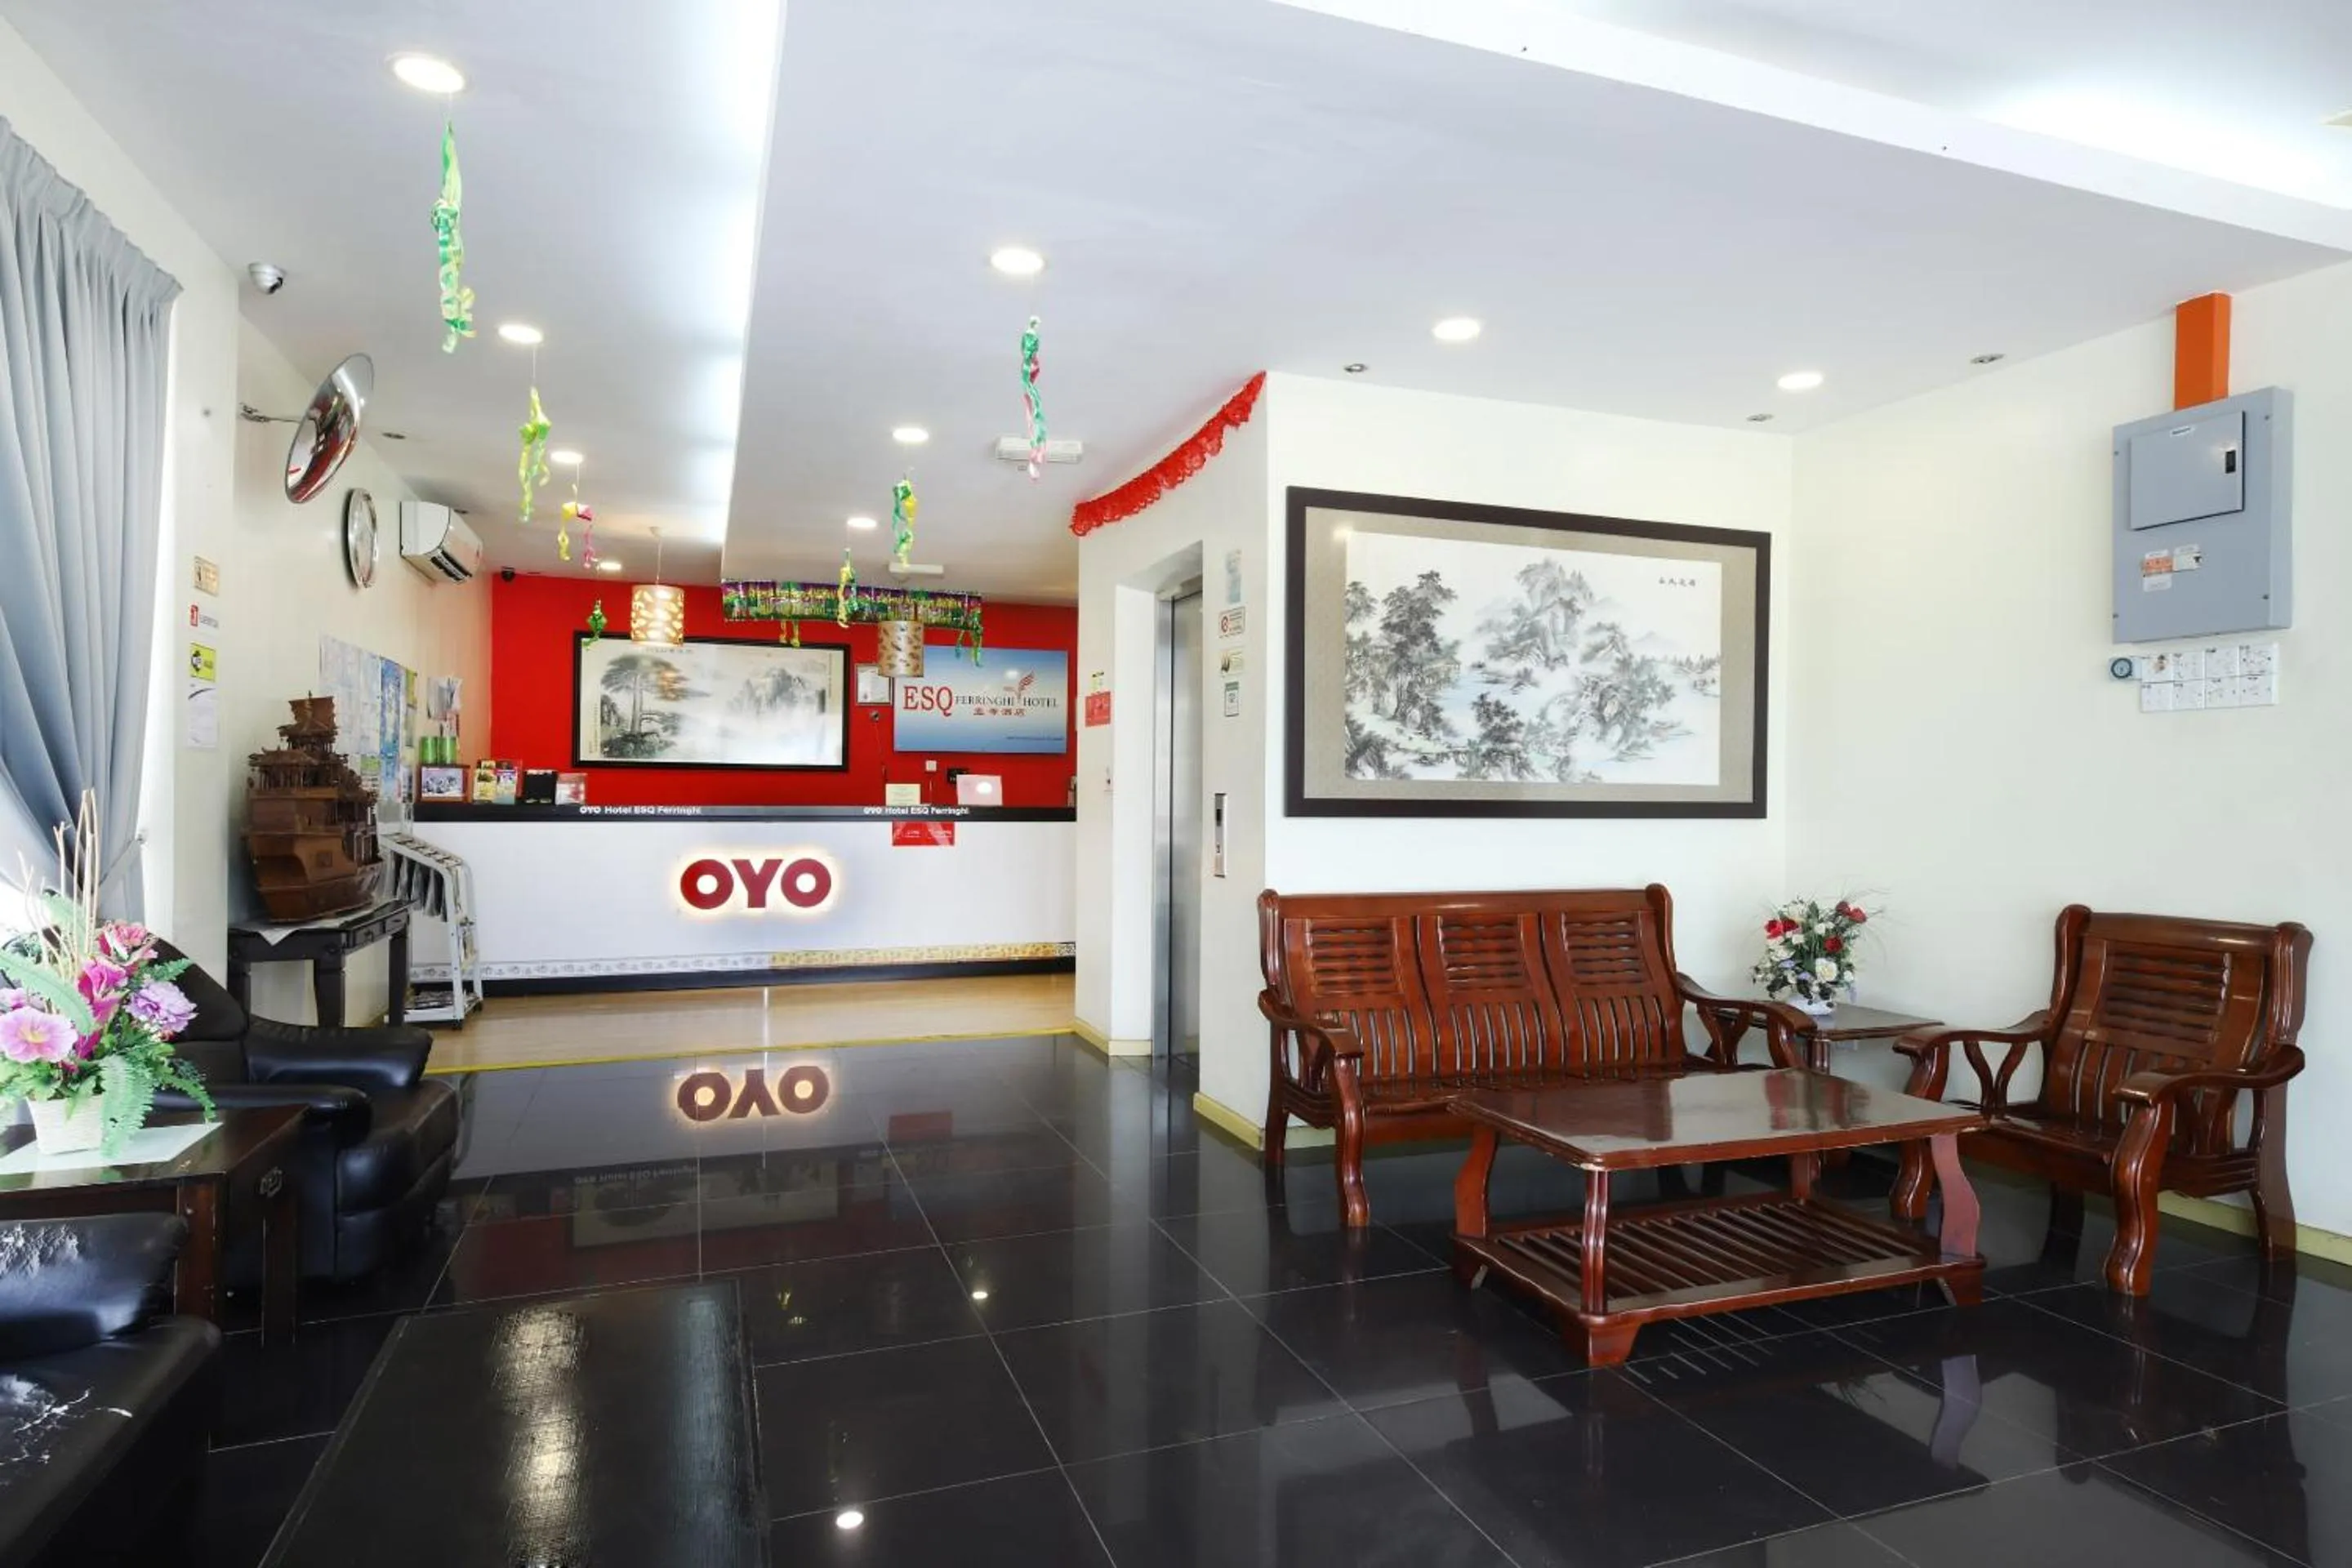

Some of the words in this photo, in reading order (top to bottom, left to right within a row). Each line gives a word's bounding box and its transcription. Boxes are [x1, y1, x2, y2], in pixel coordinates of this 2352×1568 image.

[903, 686, 954, 717] ESQ
[955, 694, 1015, 706] FERRINGHI
[1023, 697, 1060, 708] HOTEL
[579, 804, 601, 814] OYO
[604, 804, 631, 814] Hotel
[634, 805, 655, 814] ESQ
[863, 806, 882, 815] OYO
[884, 806, 909, 815] Hotel
[911, 806, 929, 815] ESQ
[680, 858, 831, 910] OYO
